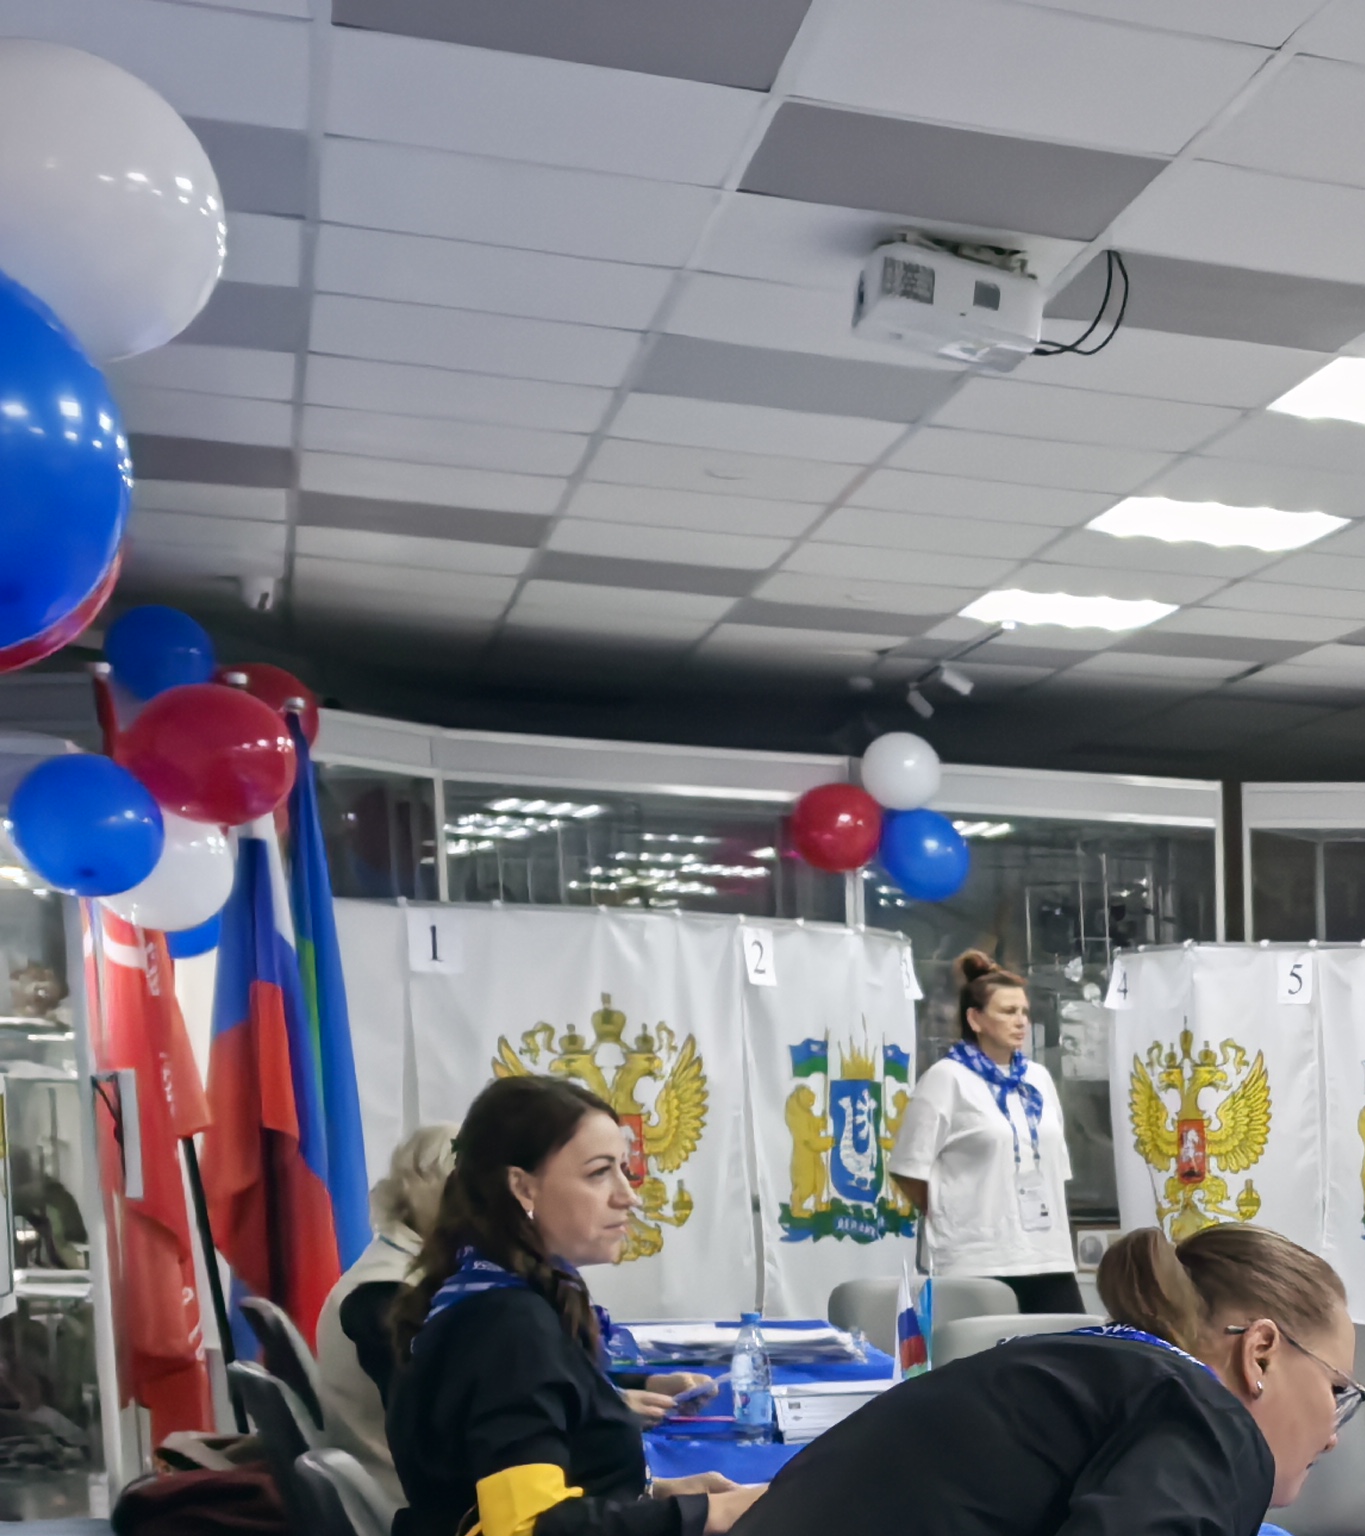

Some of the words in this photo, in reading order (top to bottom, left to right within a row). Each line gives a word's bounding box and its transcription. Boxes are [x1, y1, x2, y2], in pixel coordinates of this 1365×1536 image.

[430, 924, 443, 962] 1
[750, 939, 767, 975] 2
[1116, 970, 1128, 1000] 4
[1287, 963, 1304, 995] 5
